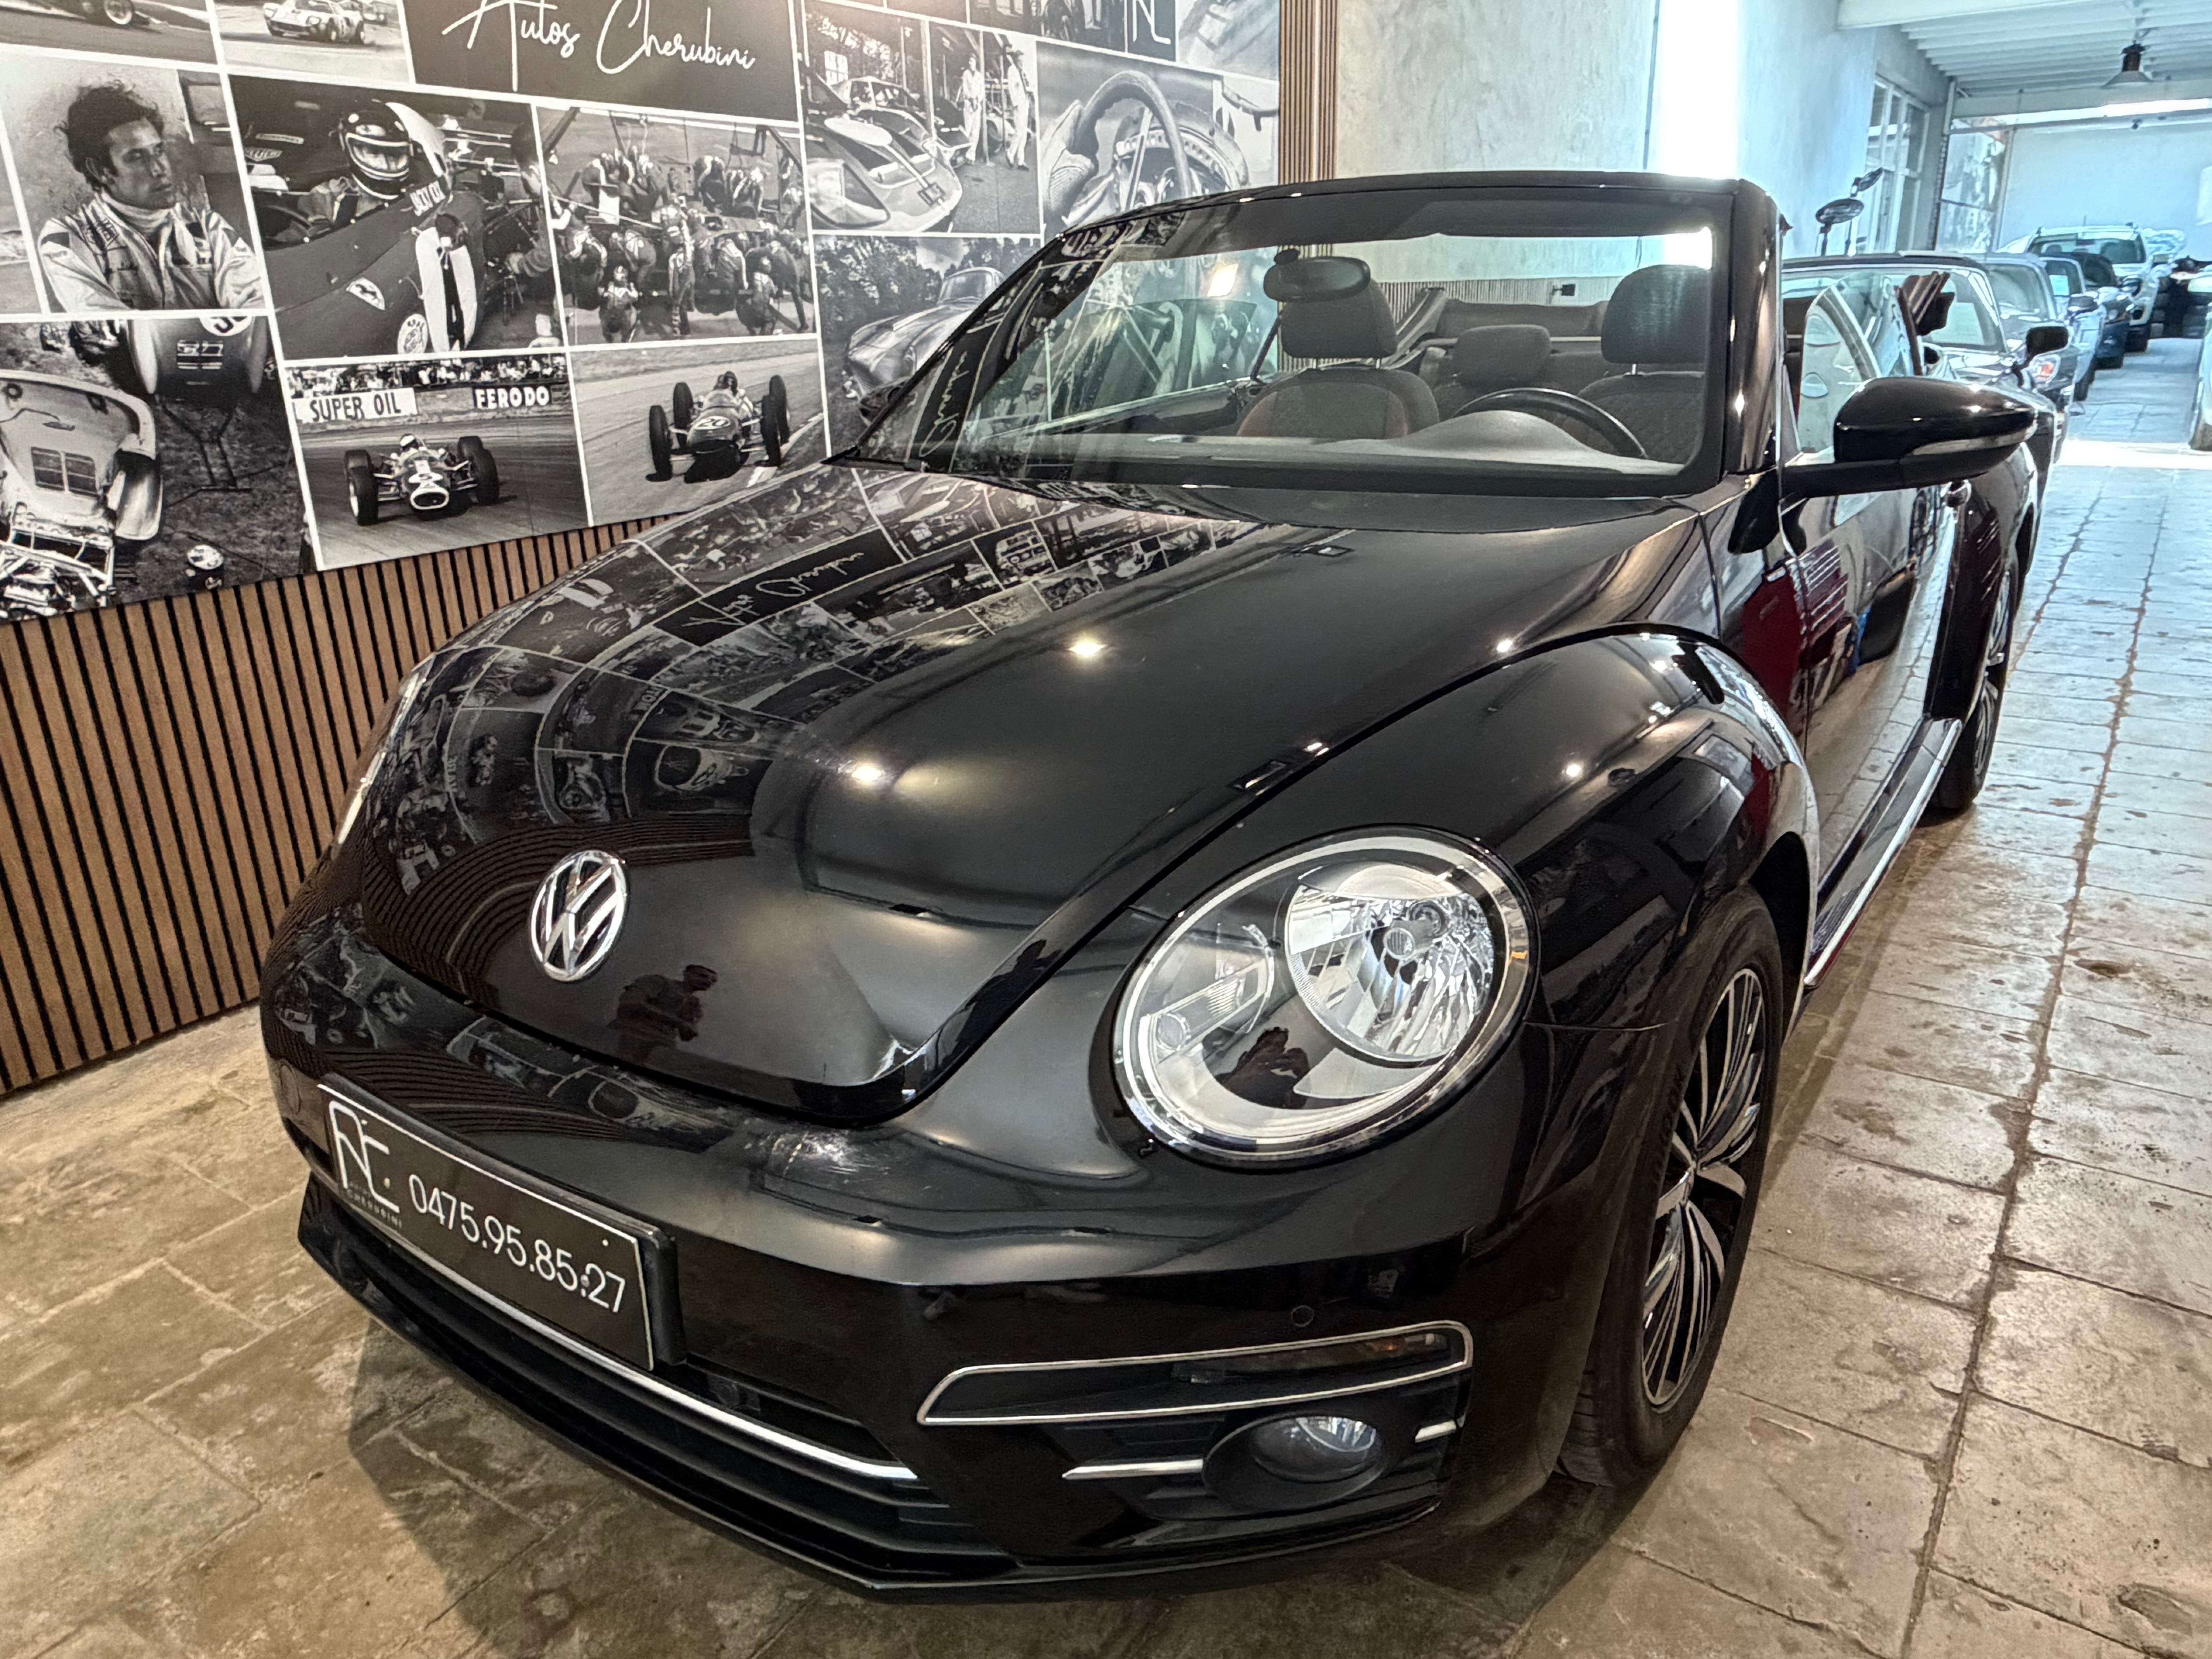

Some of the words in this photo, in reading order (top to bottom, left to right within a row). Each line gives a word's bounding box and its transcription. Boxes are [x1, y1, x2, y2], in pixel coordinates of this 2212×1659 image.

[441, 0, 580, 92] Autos
[596, 0, 756, 74] Cherubini
[310, 396, 365, 422] SUPER
[374, 392, 401, 415] OIL
[475, 386, 549, 409] FERODO
[697, 418, 729, 427] 20
[409, 1174, 625, 1313] 0475.95.85.27
